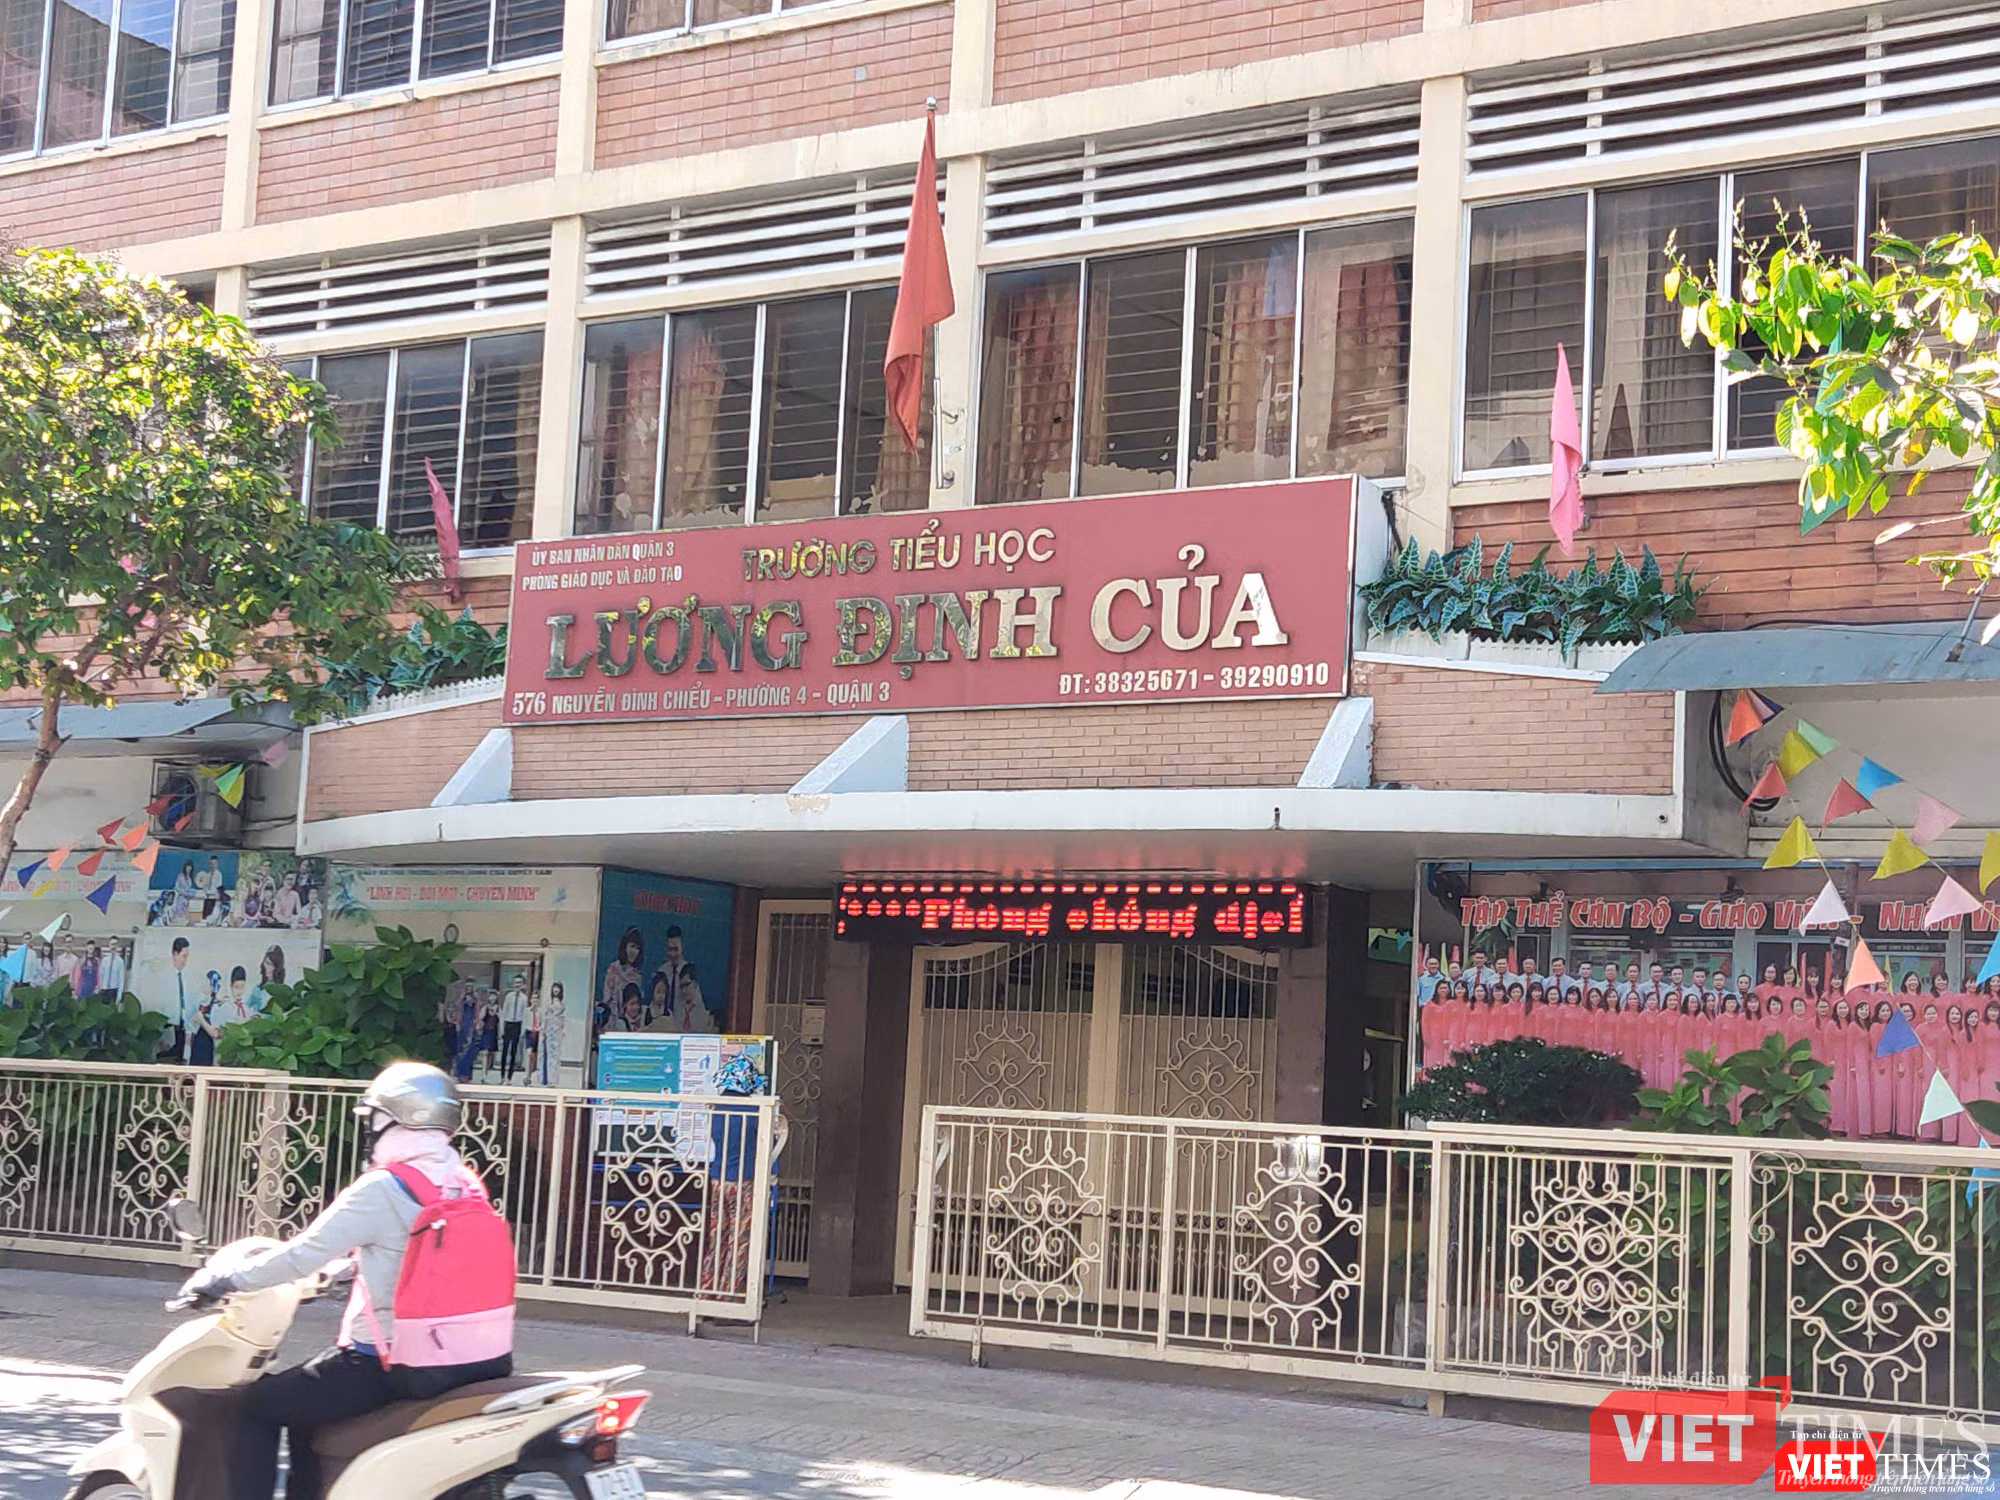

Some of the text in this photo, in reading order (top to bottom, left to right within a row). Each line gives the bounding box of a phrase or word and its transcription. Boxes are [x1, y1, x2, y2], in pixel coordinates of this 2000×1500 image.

[549, 548, 572, 564] BAN
[574, 544, 605, 562] NHÂN
[632, 540, 663, 561] QUẬN
[666, 541, 674, 556] 3
[742, 518, 1055, 581] TRƯỜNG TIỂU HỌC
[522, 564, 682, 591] PHÒNG GIÁO DỤC VÀ ĐÀO TẠO
[544, 544, 1288, 681] LƯƠNG ĐỊNH CỦA
[1095, 669, 1198, 693] 38325671
[1220, 663, 1329, 689] 39290910
[512, 692, 546, 716] 576
[552, 686, 615, 714] NGUYỄN
[621, 688, 658, 712] ĐÌNH
[663, 681, 711, 710] CHIỂU
[726, 682, 790, 708] PHƯỜNG
[796, 686, 807, 704] 4
[827, 679, 872, 708] QUẬN
[879, 682, 890, 701] 3
[1461, 896, 1508, 932] TẬP
[1515, 890, 1565, 928] THỂ
[1570, 897, 1625, 928] CÁN
[1631, 896, 1672, 934] BỘ
[1700, 898, 1767, 929] GIÁO
